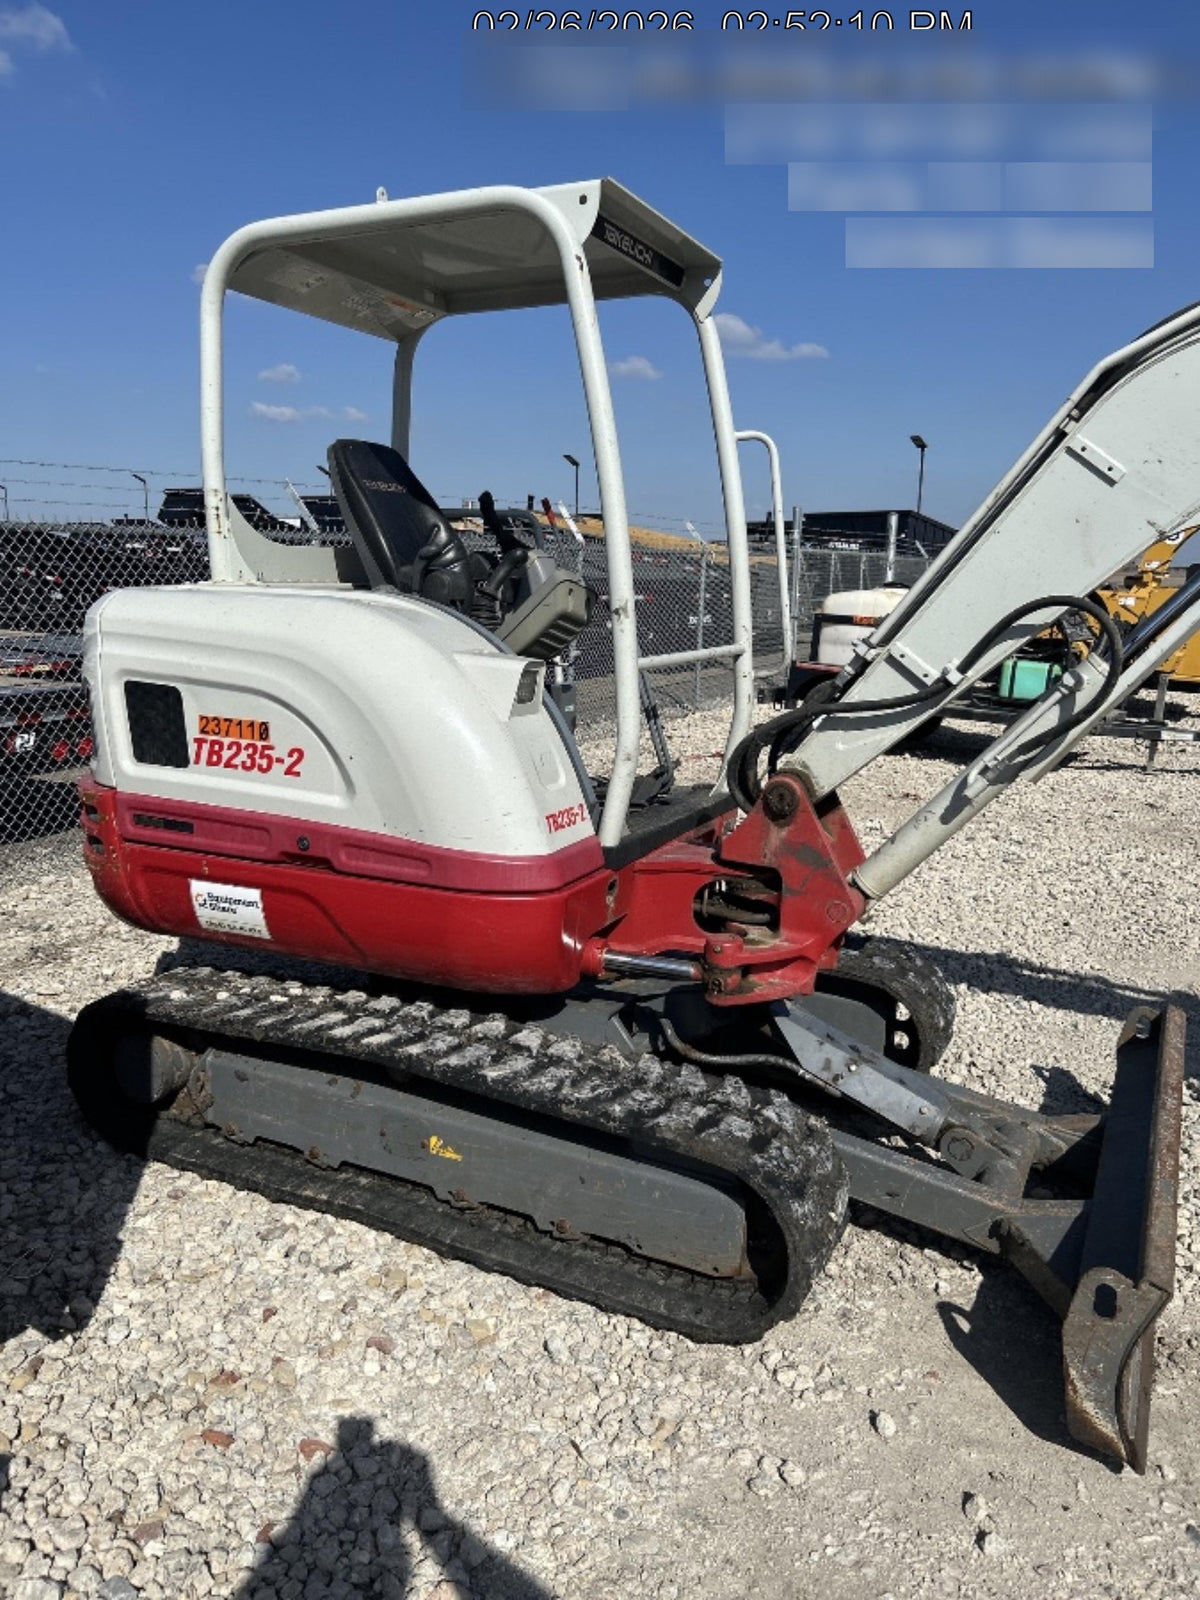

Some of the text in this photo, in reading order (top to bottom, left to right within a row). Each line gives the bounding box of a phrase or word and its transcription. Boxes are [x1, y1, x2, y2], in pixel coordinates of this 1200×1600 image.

[199, 715, 270, 742] 237110
[193, 737, 305, 777] TB235-2
[545, 803, 587, 834] TB235-2
